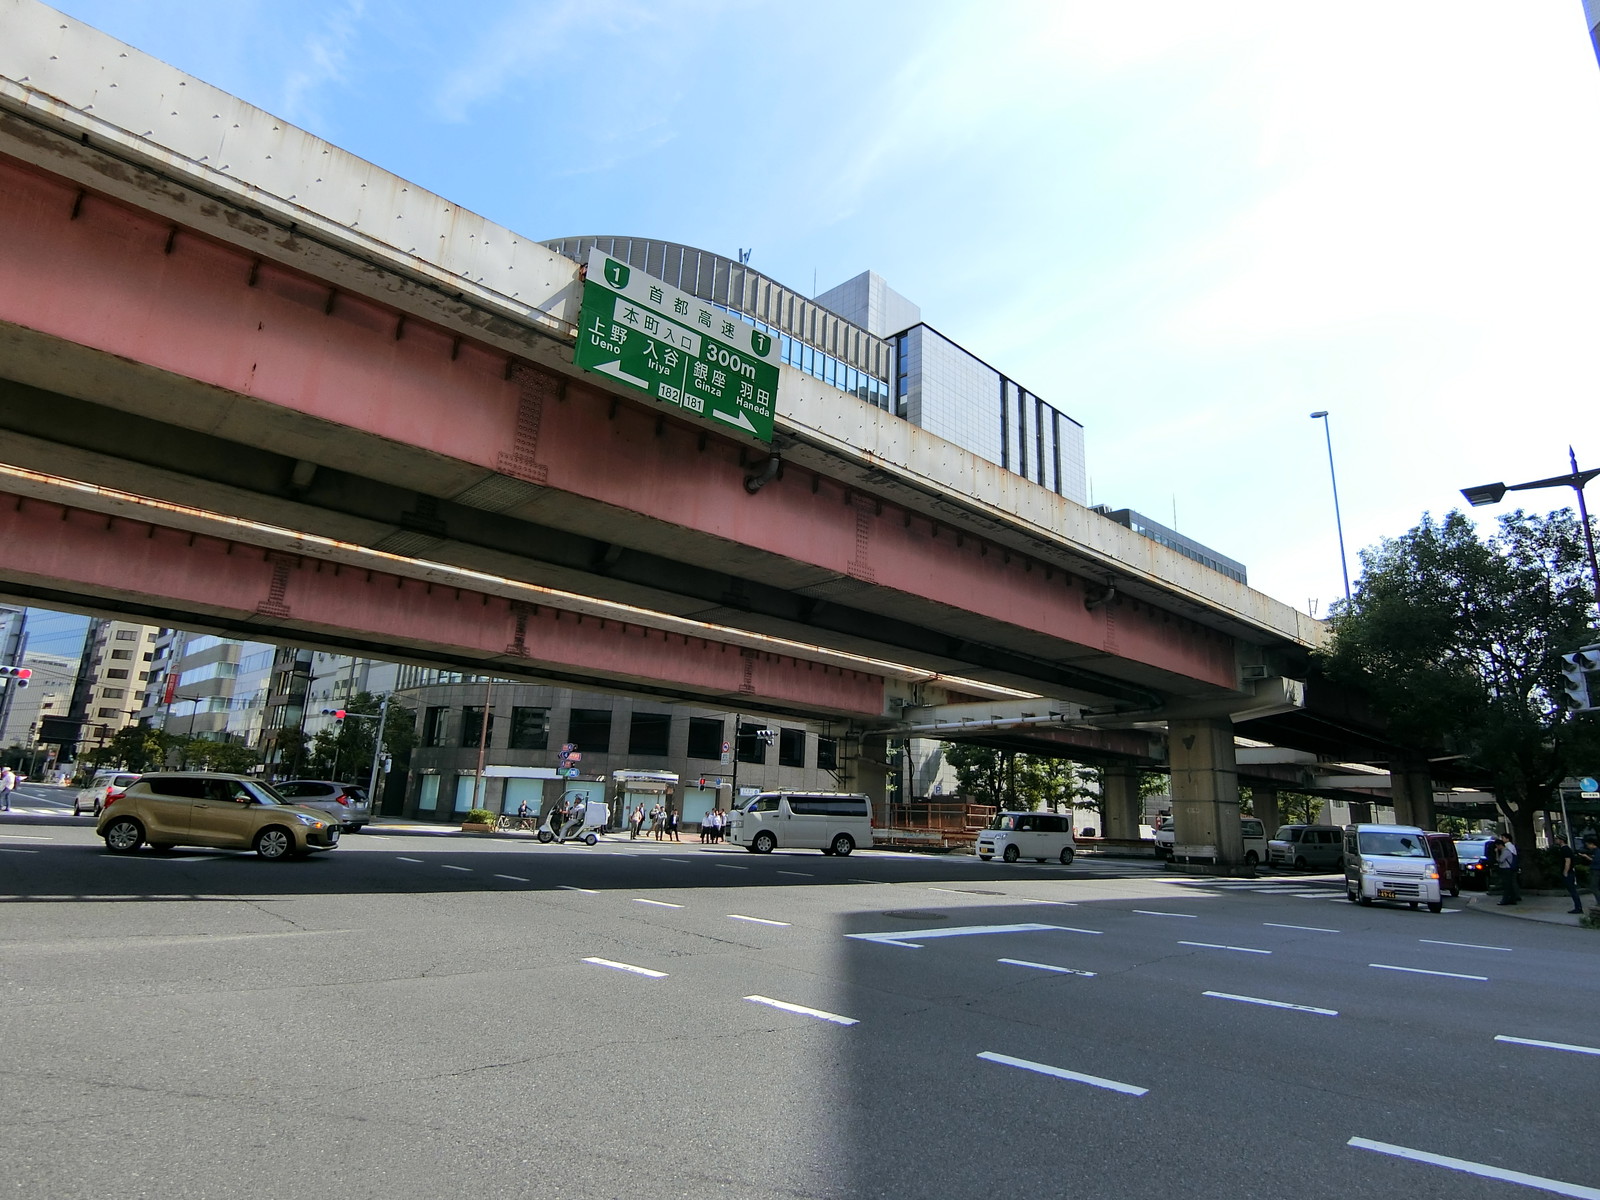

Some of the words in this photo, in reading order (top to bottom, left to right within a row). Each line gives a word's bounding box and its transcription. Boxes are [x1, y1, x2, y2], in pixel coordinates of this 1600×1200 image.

[649, 285, 735, 340] 首都高速
[588, 316, 628, 345] 上野
[623, 307, 693, 351] 本町入口
[591, 334, 621, 355] Ueno
[643, 339, 679, 368] 入谷
[648, 358, 671, 376] Iriya
[693, 361, 727, 389] 銀座
[706, 343, 756, 381] 300m
[661, 385, 680, 401] 182
[695, 379, 722, 397] Ginza
[739, 381, 770, 408] 羽田
[686, 395, 702, 411] 181
[736, 396, 770, 418] Haneda
